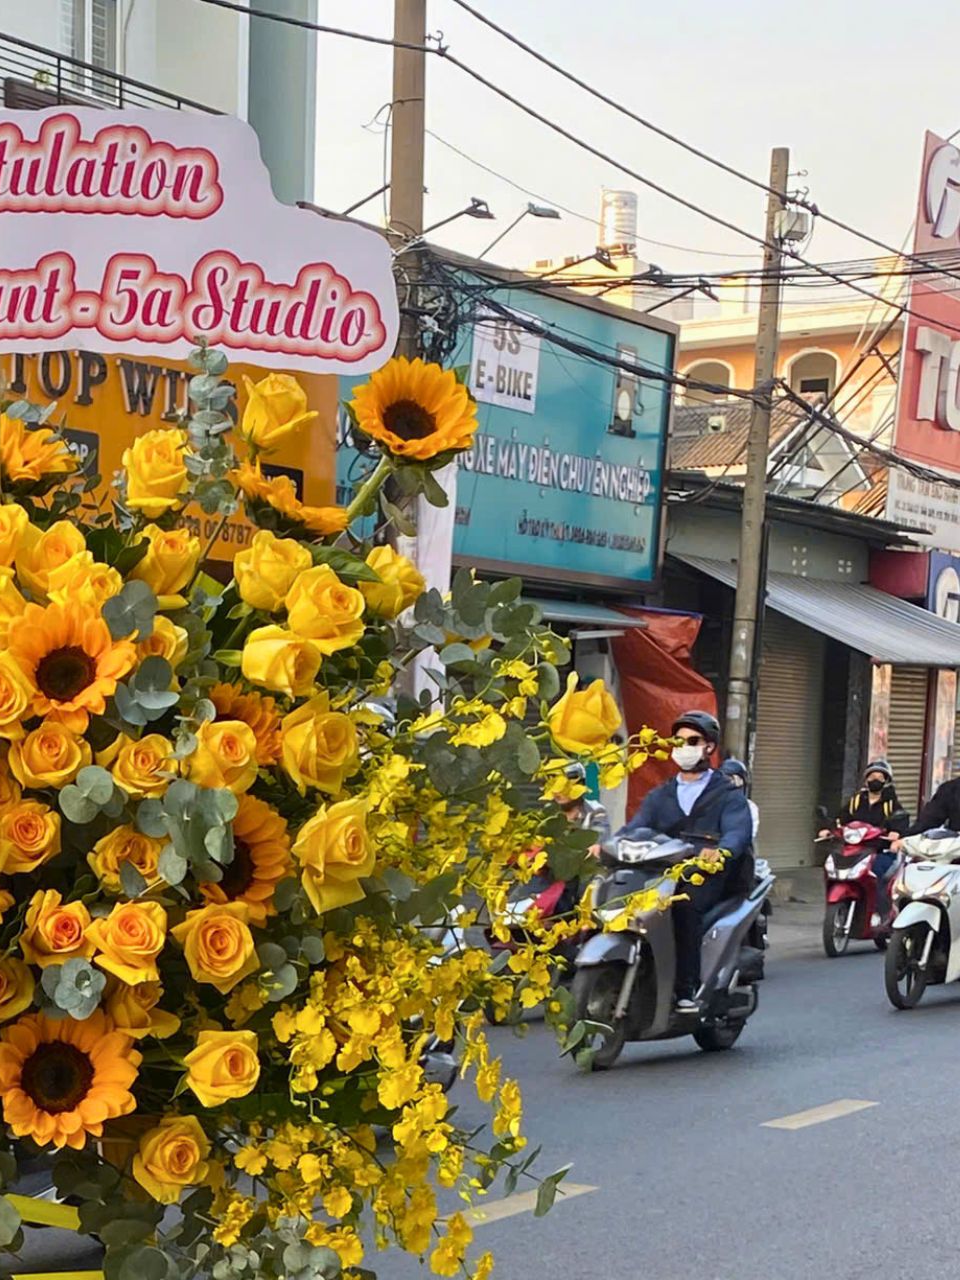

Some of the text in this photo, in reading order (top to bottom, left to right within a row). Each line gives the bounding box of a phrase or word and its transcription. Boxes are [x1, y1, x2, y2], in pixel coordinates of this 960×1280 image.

[109, 268, 179, 328] 5a
[191, 265, 373, 348] Studio
[475, 433, 495, 475] XE
[496, 427, 528, 481] MÁY
